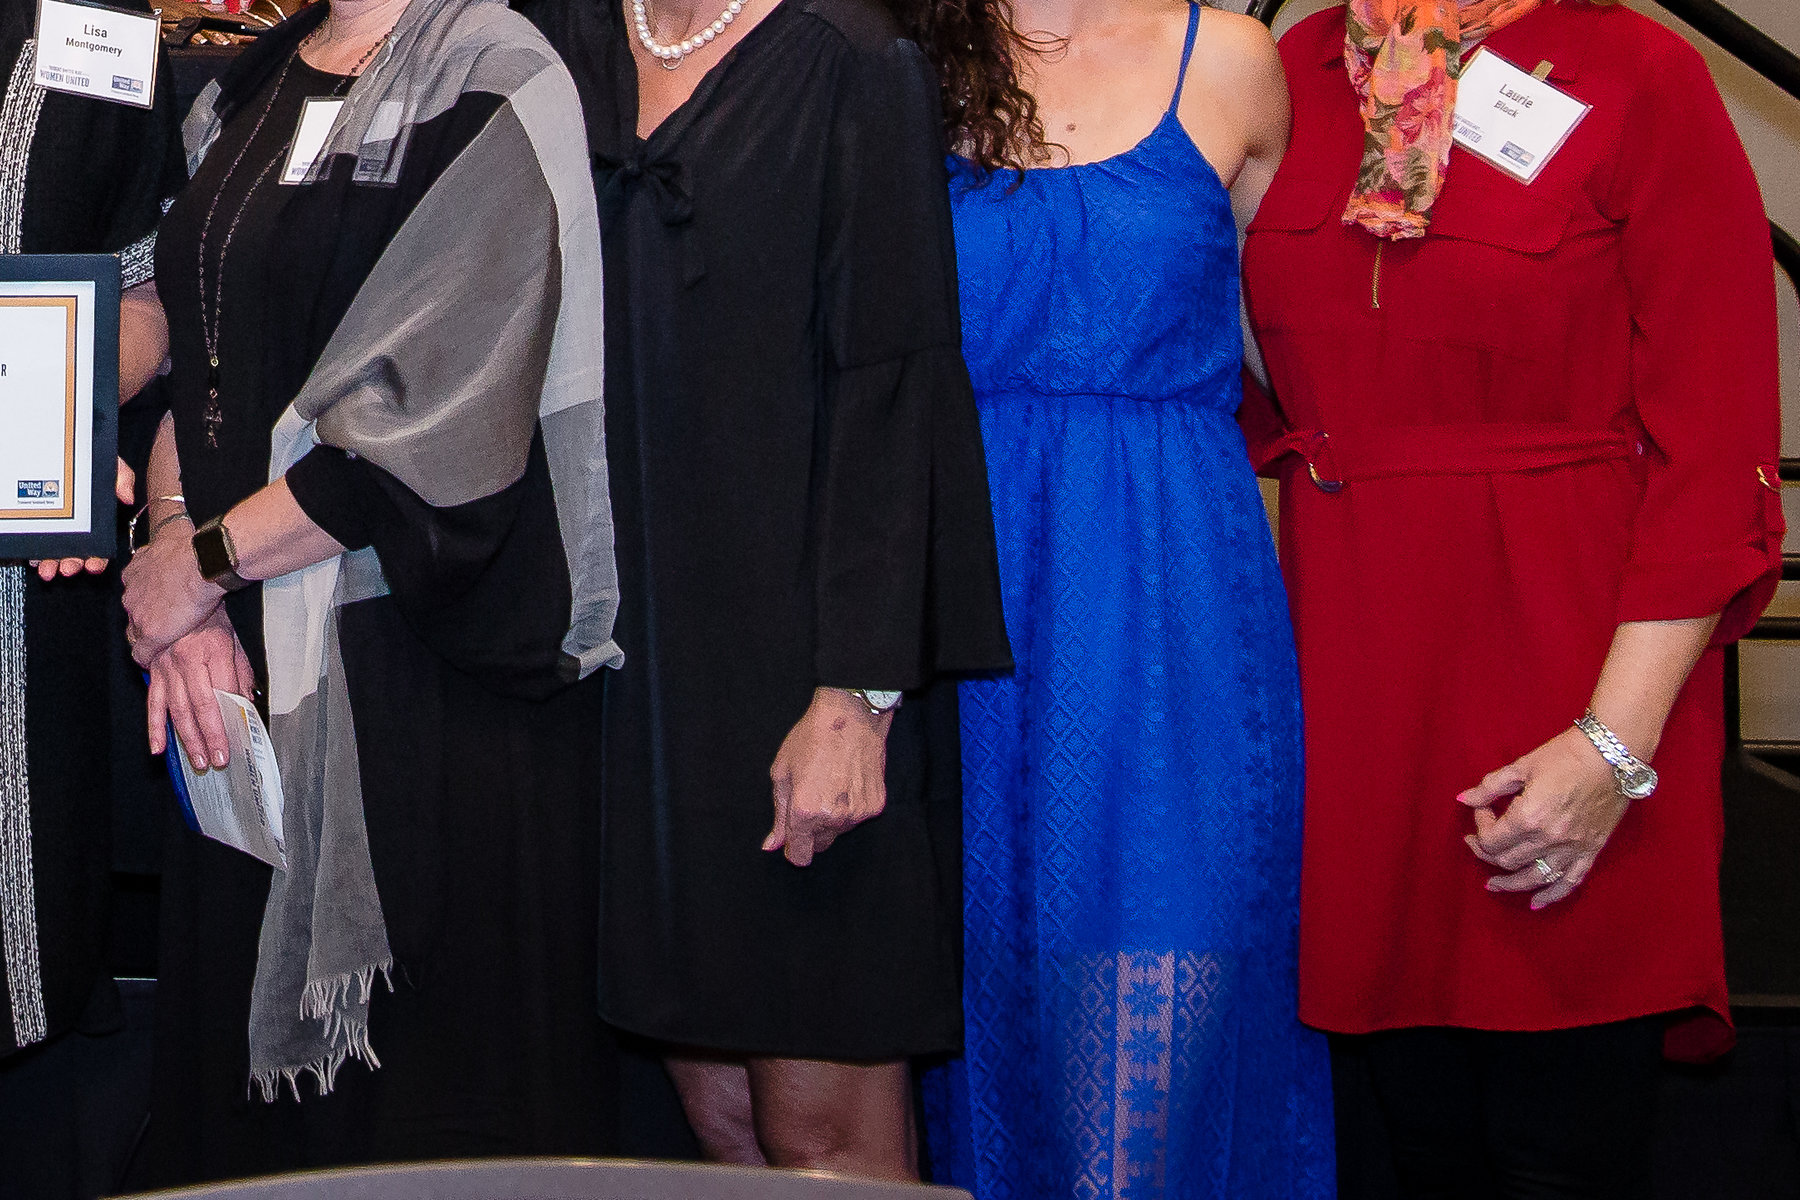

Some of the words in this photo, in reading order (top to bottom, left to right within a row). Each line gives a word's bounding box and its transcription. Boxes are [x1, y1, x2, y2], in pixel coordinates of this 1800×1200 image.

[84, 24, 108, 38] Lisa
[65, 37, 123, 57] Montgomery
[1499, 84, 1534, 109] Laurie
[19, 481, 42, 489] United
[27, 488, 42, 498] Way
